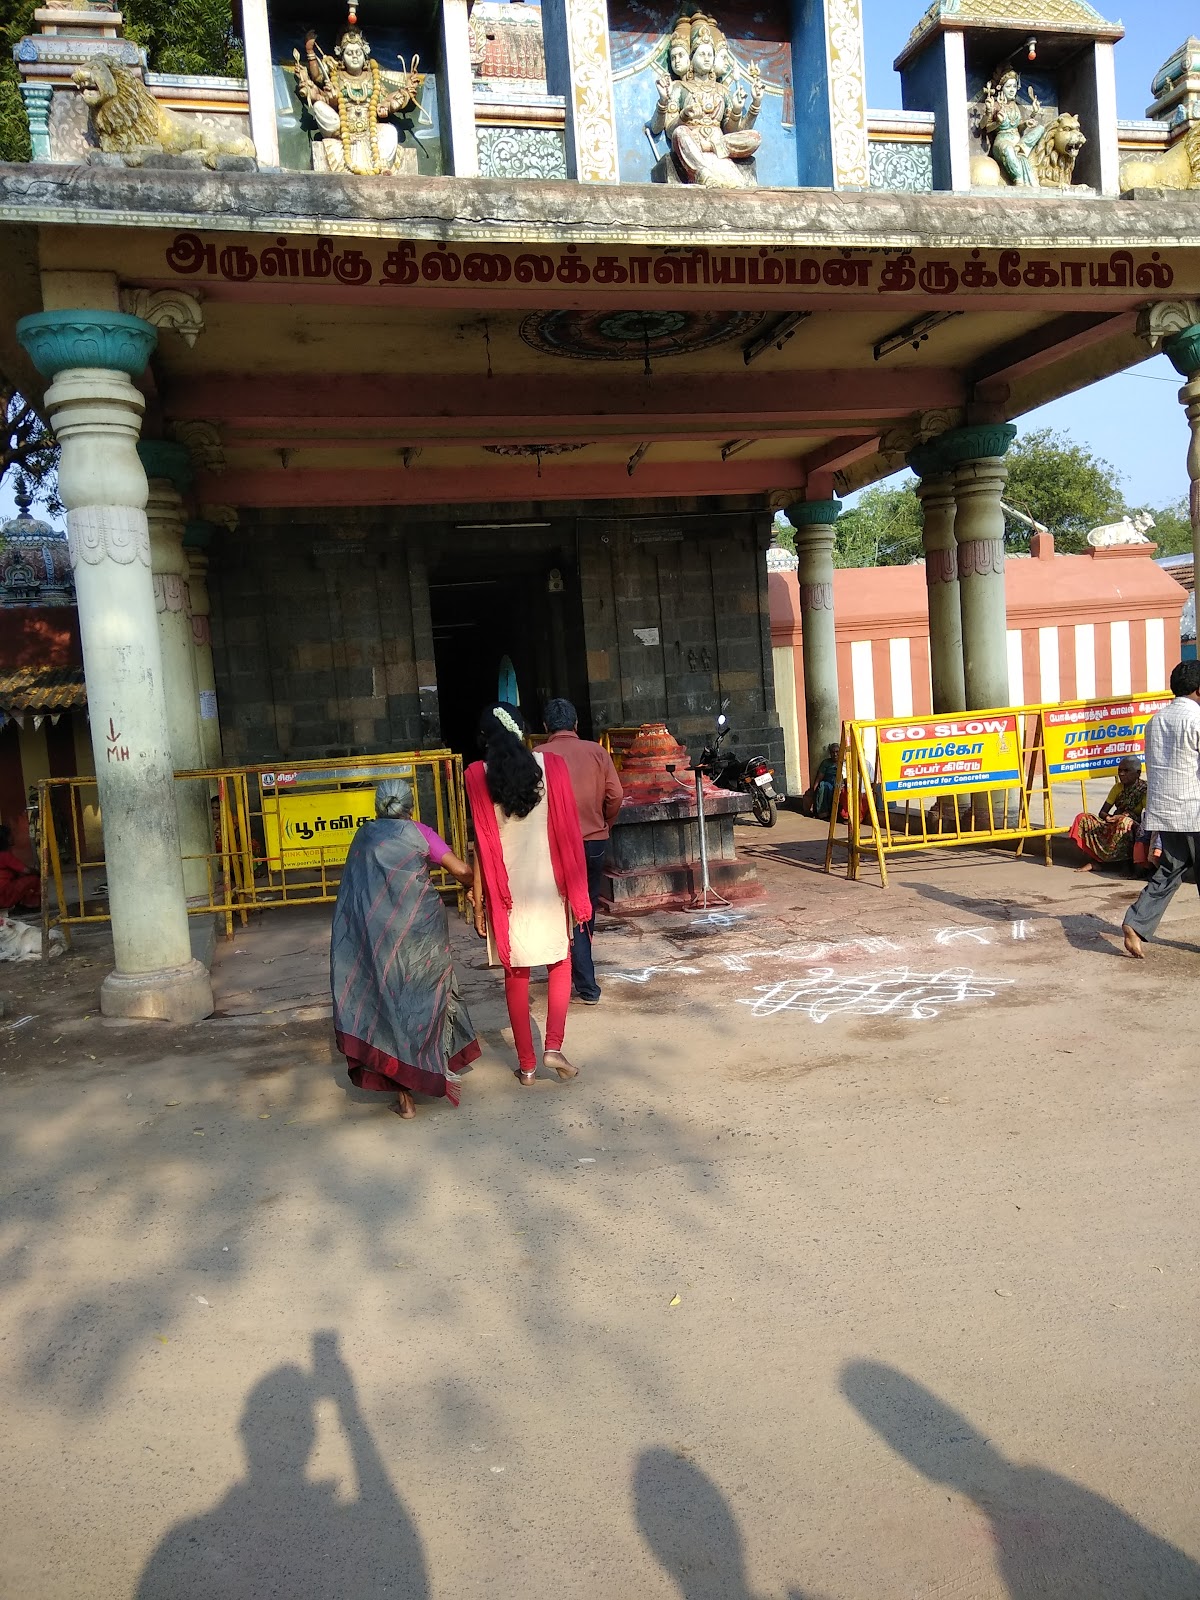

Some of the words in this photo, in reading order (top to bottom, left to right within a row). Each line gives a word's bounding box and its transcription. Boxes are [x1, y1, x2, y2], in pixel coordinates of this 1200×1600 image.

[166, 233, 372, 285] அருள்மிகு
[379, 240, 872, 286] தில்லைக்காளியம்மன்
[878, 249, 1174, 294] திருக்கோயில்
[1110, 704, 1135, 715] காவல்
[886, 726, 926, 741] GO
[935, 720, 1008, 737] SLOW
[1064, 723, 1146, 746] ராம்கோ
[107, 746, 130, 762] MH
[901, 742, 985, 763] ராம்கோ
[1066, 745, 1103, 759] சூப்பர்
[903, 763, 940, 777] சூப்பர்
[1060, 760, 1101, 771] Engineered
[1103, 758, 1114, 766] for
[897, 777, 939, 790] Engineered
[941, 776, 952, 784] for
